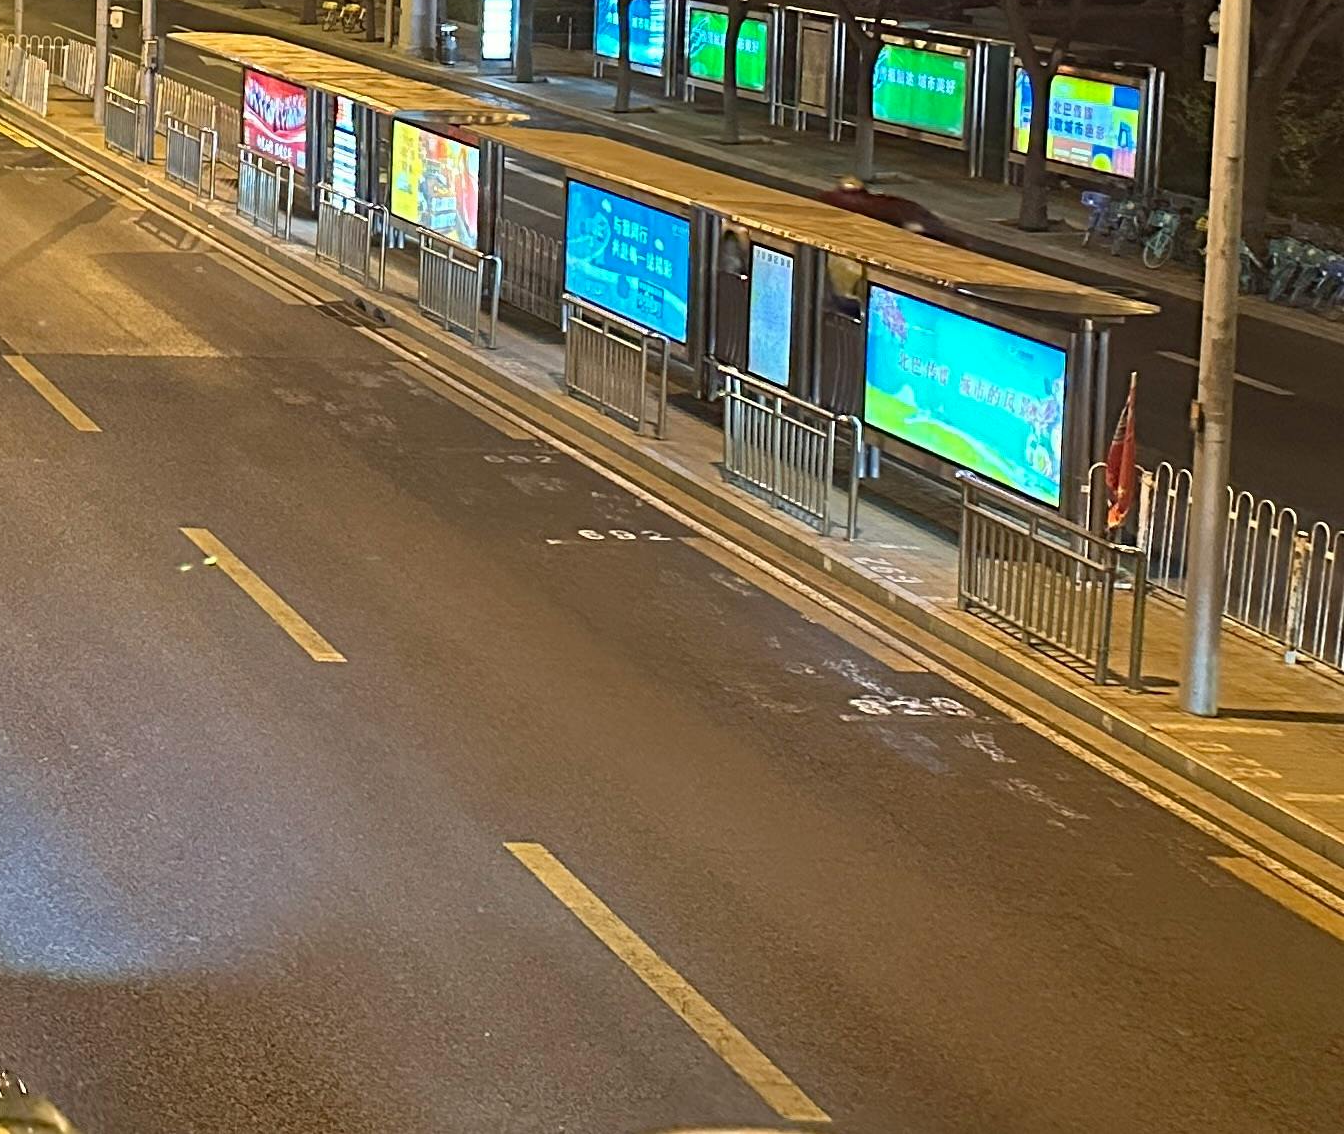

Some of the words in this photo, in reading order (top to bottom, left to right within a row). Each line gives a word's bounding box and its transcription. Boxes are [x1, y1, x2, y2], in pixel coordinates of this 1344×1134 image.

[898, 352, 950, 386] 北巴传媒
[578, 529, 672, 541] 692
